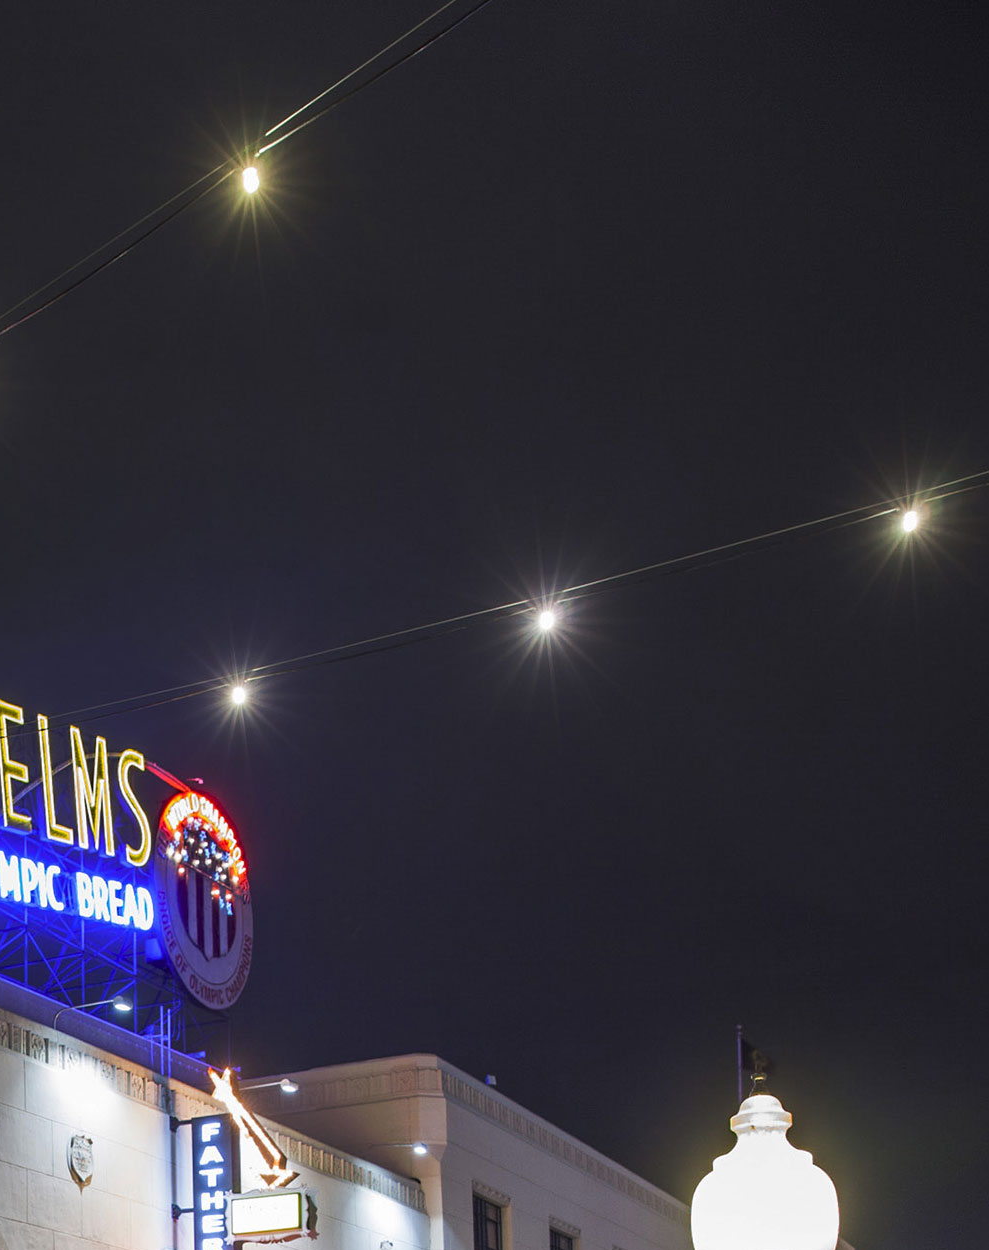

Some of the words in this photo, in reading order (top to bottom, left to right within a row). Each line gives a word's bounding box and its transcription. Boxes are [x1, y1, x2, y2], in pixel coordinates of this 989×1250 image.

[166, 793, 199, 830] WORLD
[76, 872, 154, 931] BREAD
[158, 890, 176, 952] CHOICE
[175, 955, 188, 974] OF
[189, 974, 224, 1005] OLYMPIC
[225, 934, 252, 1003] CHAMPIONS
